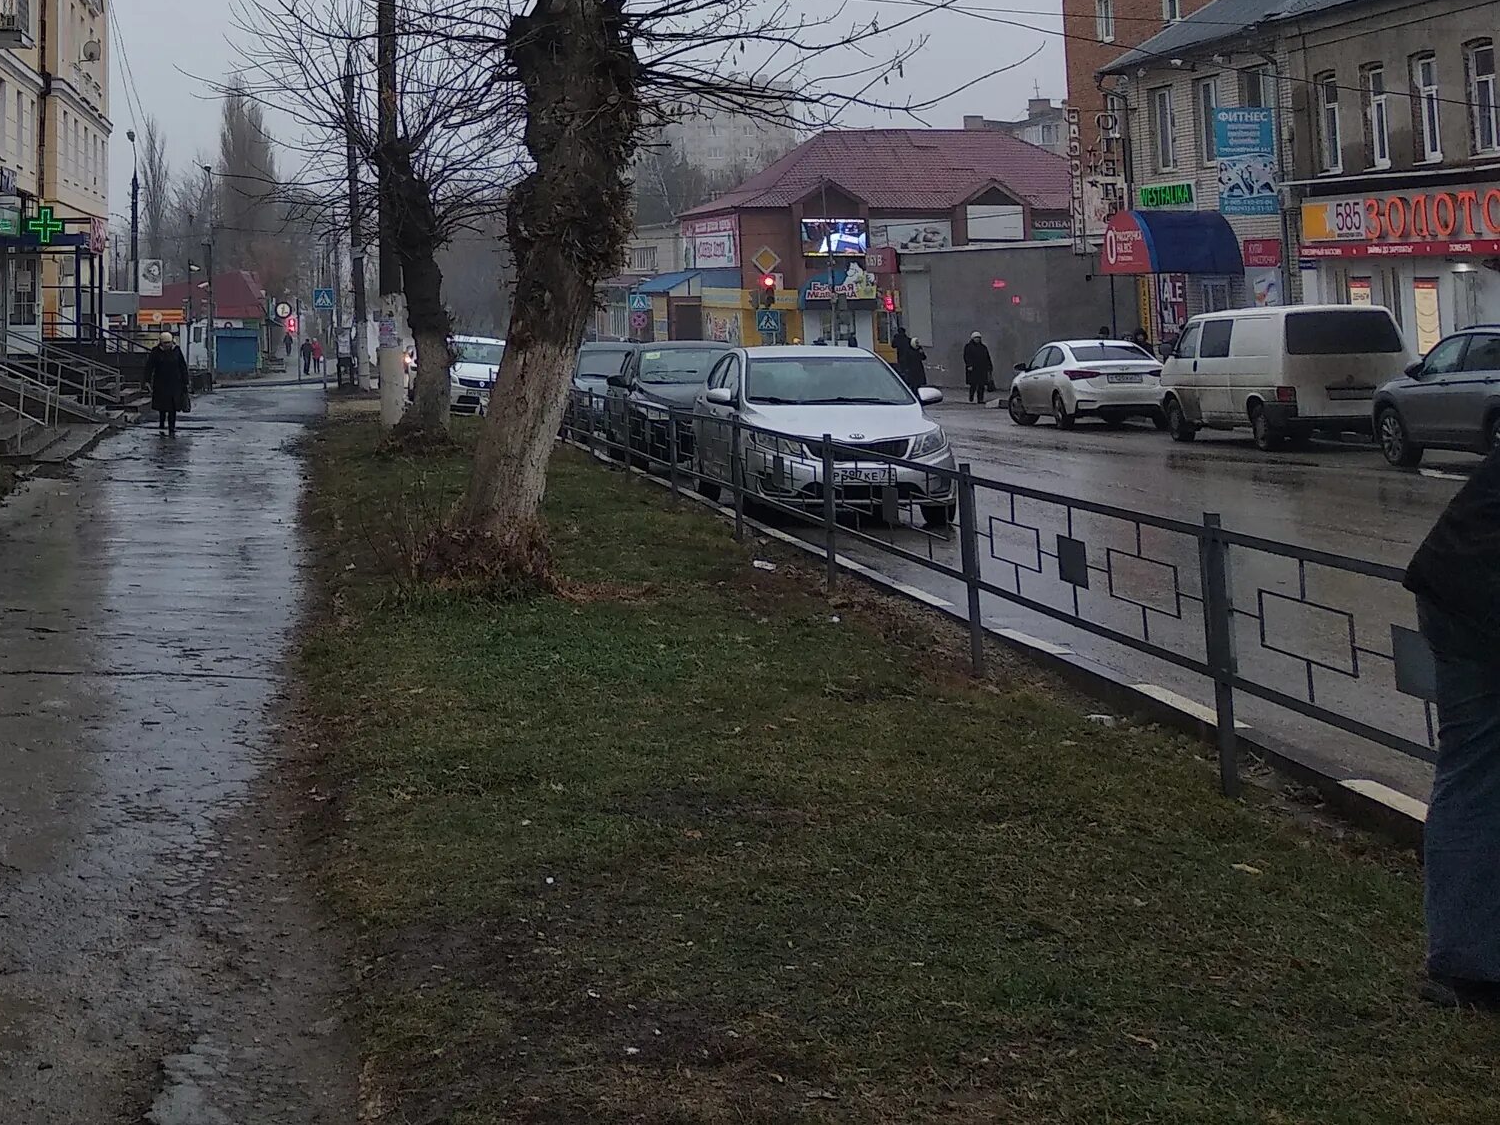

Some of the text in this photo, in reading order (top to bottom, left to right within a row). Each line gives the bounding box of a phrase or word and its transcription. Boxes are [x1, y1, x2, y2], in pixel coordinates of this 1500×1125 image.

[1218, 111, 1268, 122] ФИТНЕС
[1140, 183, 1194, 207] WESTFALIKA
[1335, 201, 1362, 231] 585
[1160, 281, 1184, 303] ALE
